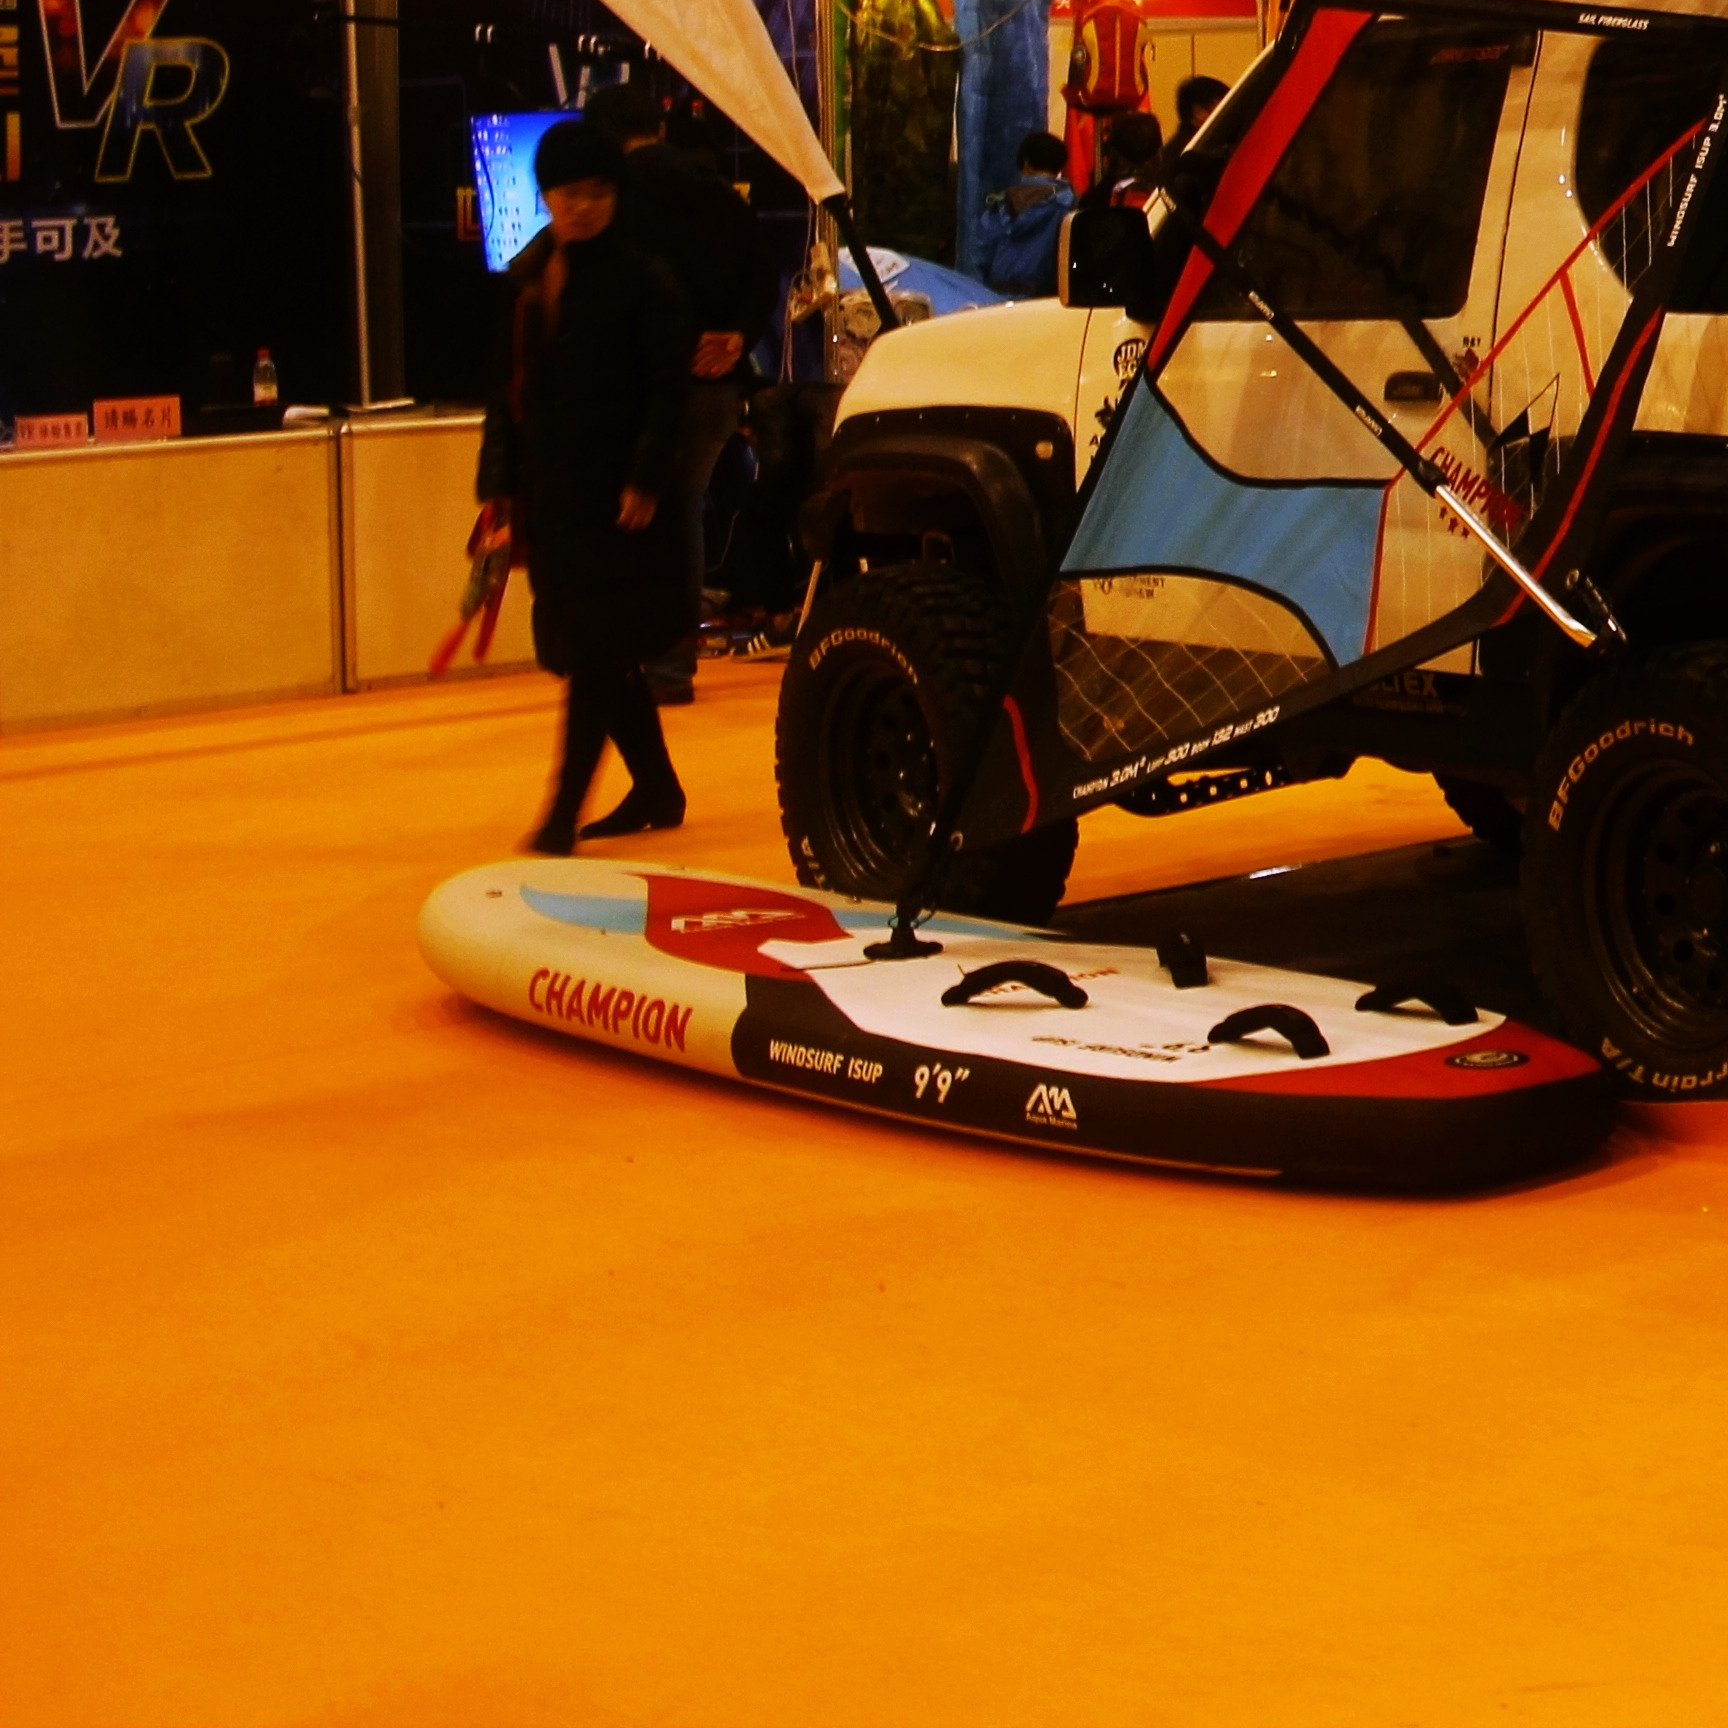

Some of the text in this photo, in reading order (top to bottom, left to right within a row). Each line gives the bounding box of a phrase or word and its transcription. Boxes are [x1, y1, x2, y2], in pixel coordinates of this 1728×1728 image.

[1694, 136, 1712, 169] ISUP
[1073, 777, 1109, 799] CHAMPION
[1547, 718, 1694, 831] BFGoodrich
[528, 969, 693, 1053] CHAMPION
[769, 1039, 845, 1075] WINDSURF
[847, 1058, 883, 1084] ISUP
[1026, 1111, 1078, 1131] Aqua Marina
